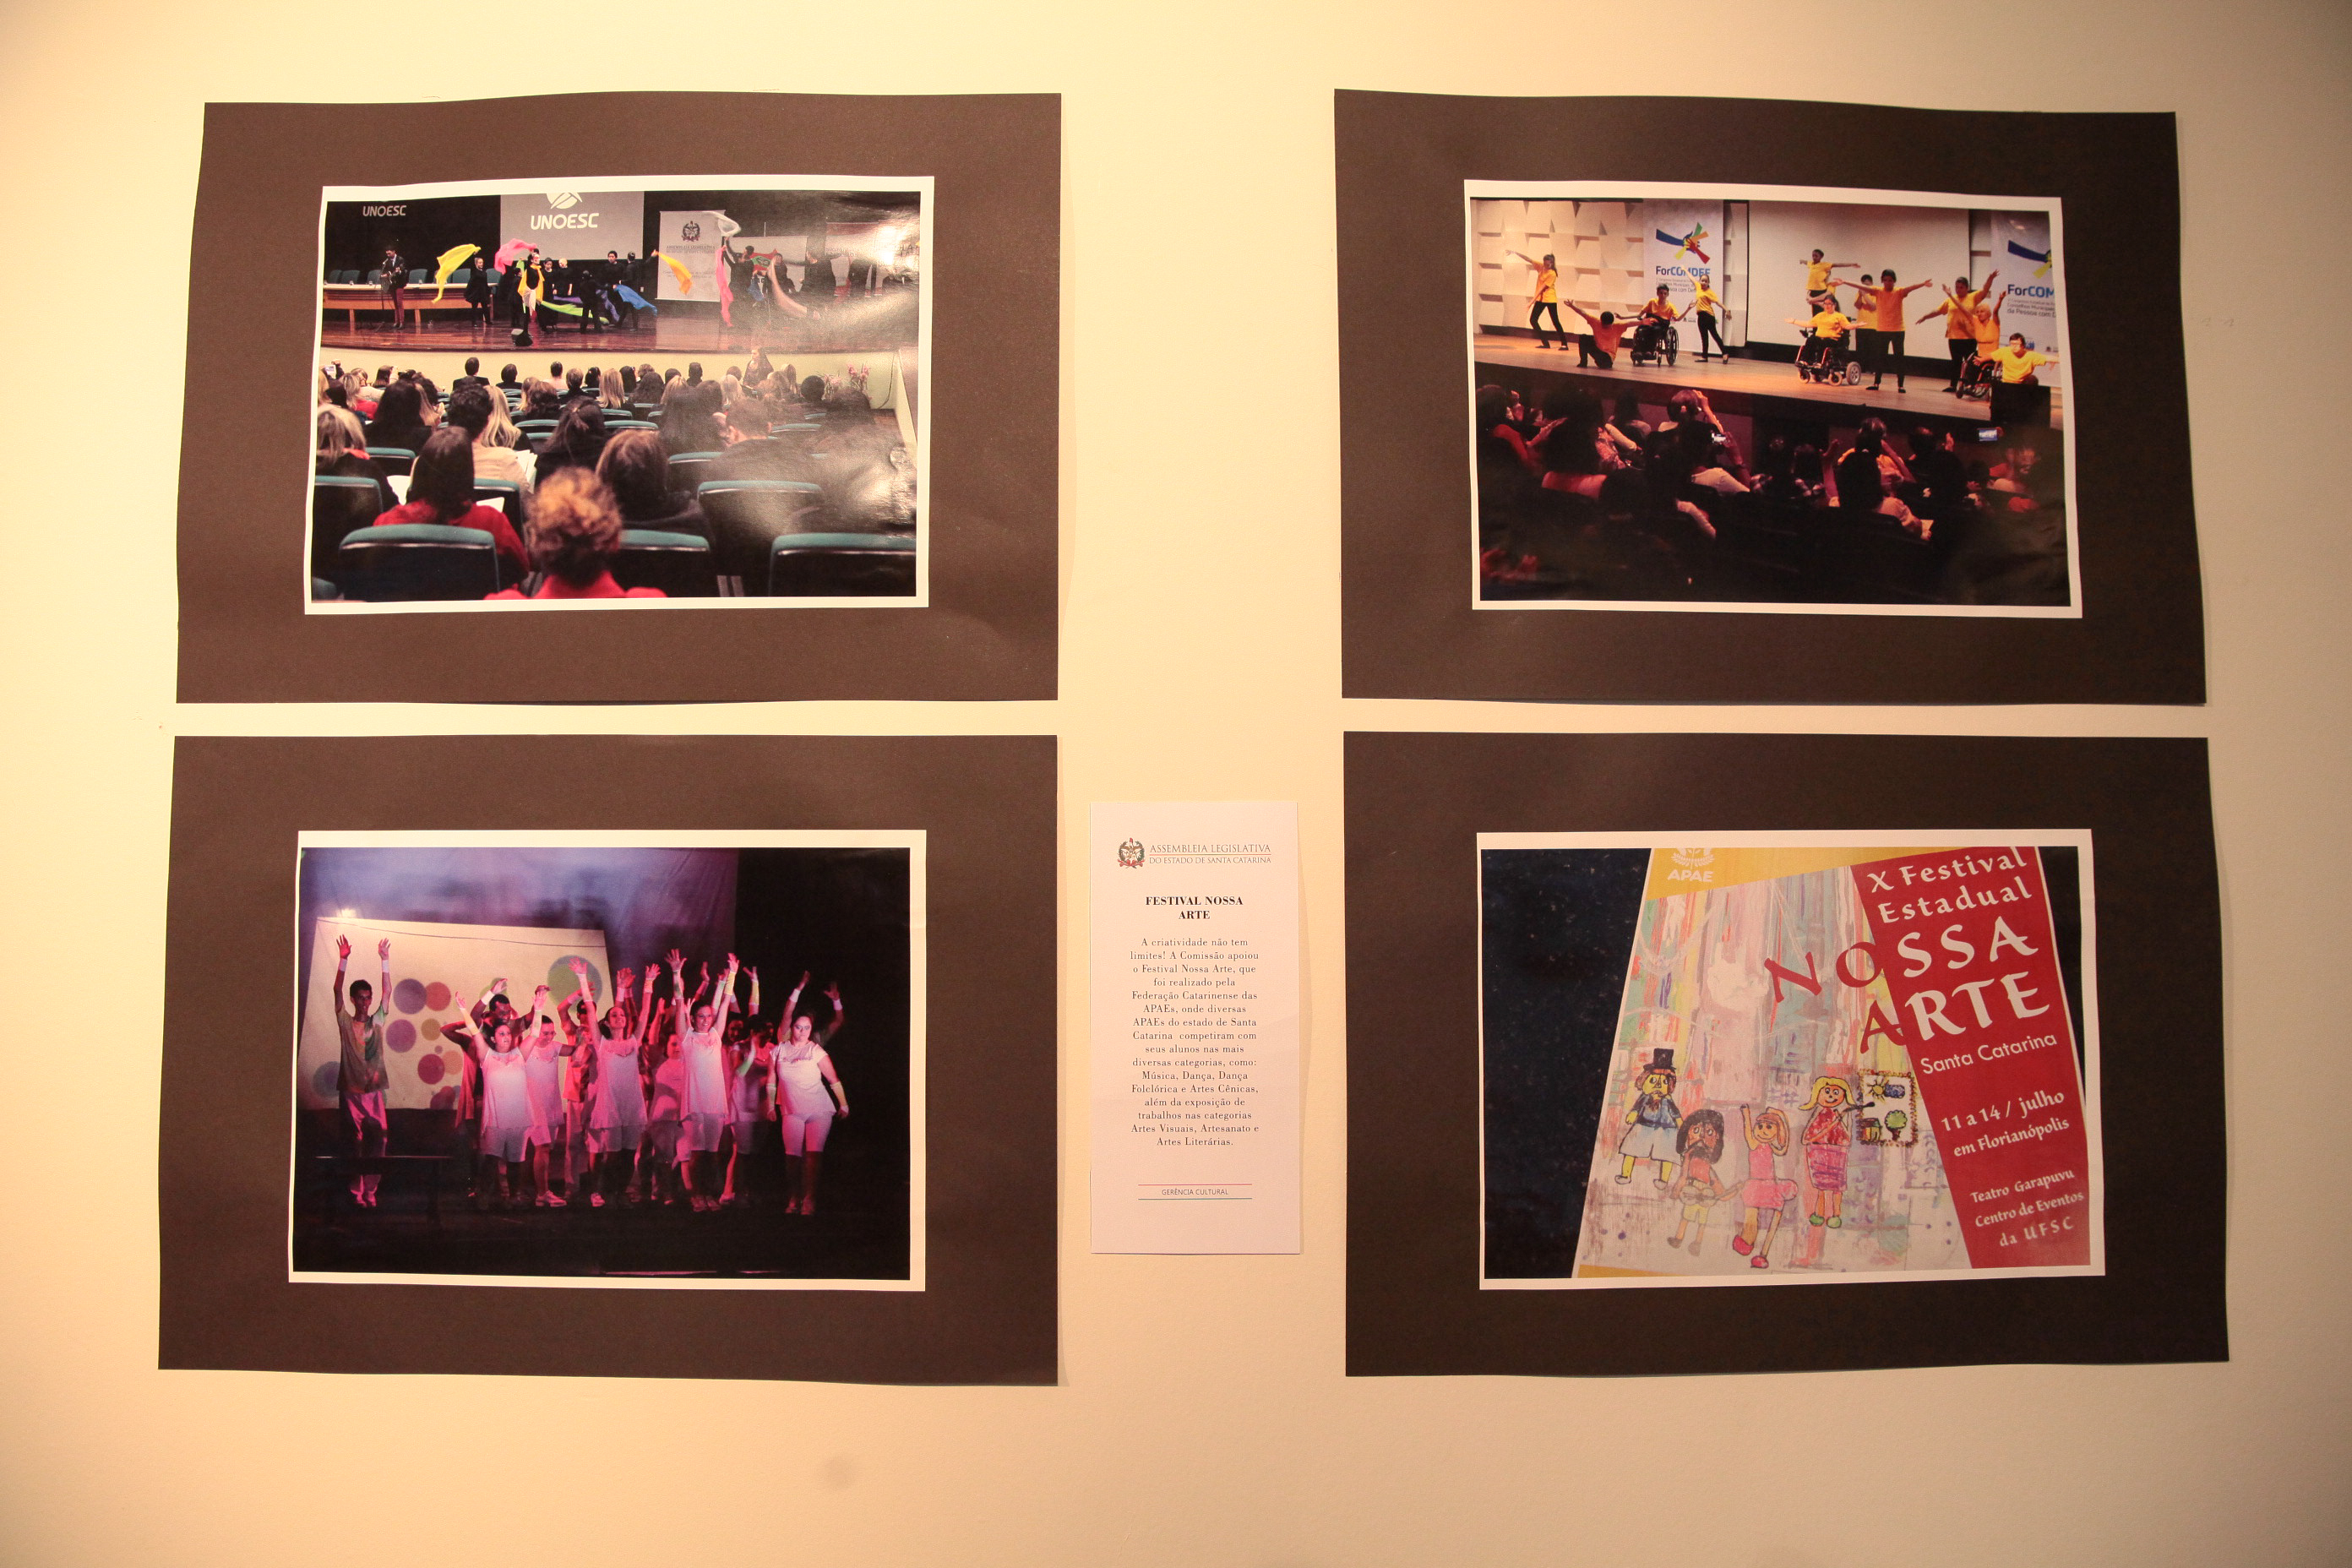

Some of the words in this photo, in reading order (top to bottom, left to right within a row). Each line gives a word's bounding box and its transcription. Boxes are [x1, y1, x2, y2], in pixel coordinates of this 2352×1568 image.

[362, 204, 407, 217] UNOESC
[531, 213, 600, 231] UNOESC
[1211, 844, 1271, 853] LEGISLATIVA
[1667, 869, 1713, 882] APAE
[1867, 871, 1894, 893] X
[1899, 847, 2027, 885] Festival
[1146, 896, 1201, 906] FESTIVAL
[1205, 896, 1244, 905] NOSSA
[1878, 876, 2033, 923] Estadual
[1179, 911, 1210, 919] ARTE
[1141, 938, 1148, 946] A
[1152, 938, 1207, 946] criatividade
[1228, 951, 1258, 961] apoiou
[1764, 916, 2039, 1004] NOSSA
[1142, 964, 1178, 972] Festival
[1182, 964, 1208, 972] Nossa
[1212, 964, 1235, 974] Arte,
[1154, 977, 1165, 986] foi
[1169, 977, 1211, 986] realizado
[1216, 977, 1235, 988] pela
[1132, 991, 1179, 1002] Federação
[1183, 991, 1238, 999] Catarinense
[1242, 991, 1257, 999] das
[1143, 1004, 1178, 1014] APAEs,
[1182, 1004, 1204, 1013] onde
[1860, 972, 2050, 1054] ARTE
[1231, 1017, 1256, 1026] Santa
[1133, 1031, 1173, 1039] Catarina
[1179, 1032, 1234, 1042] competiram
[1169, 1044, 1200, 1053] alunos
[1920, 1054, 1974, 1075] Santa
[1978, 1035, 2057, 1061] Catarina
[1133, 1058, 1171, 1066] diversas
[1175, 1058, 1225, 1068] categorias,
[1142, 1071, 1179, 1081] Música,
[1183, 1071, 1215, 1081] Dança,
[1219, 1071, 1248, 1081] Dança
[1132, 1084, 1178, 1092] Folclórica
[1190, 1084, 1214, 1092] Artes
[1218, 1084, 1258, 1094] Cênicas,
[1145, 1097, 1167, 1106] além
[1171, 1097, 1181, 1106] da
[1185, 1098, 1230, 1108] exposição
[1205, 1111, 1251, 1121] categorias
[1941, 1115, 1962, 1131] 11
[1966, 1113, 1978, 1126] a
[1979, 1105, 2001, 1122] 14
[2018, 1090, 2065, 1119] julho
[1160, 1124, 1196, 1134] Visuais,
[1200, 1124, 1250, 1134] Artesanato
[1157, 1137, 1181, 1146] Artes
[1185, 1137, 1233, 1146] Literárias.
[1953, 1143, 1976, 1157] em
[1977, 1117, 2070, 1152] Florianópolis
[1970, 1186, 2010, 1203] Teatro
[2014, 1170, 2075, 1192] Garapuvu
[1975, 1209, 2017, 1228] Centro
[2018, 1202, 2034, 1216] de
[2036, 1192, 2084, 1212] Eventos
[1999, 1233, 2017, 1247] da
